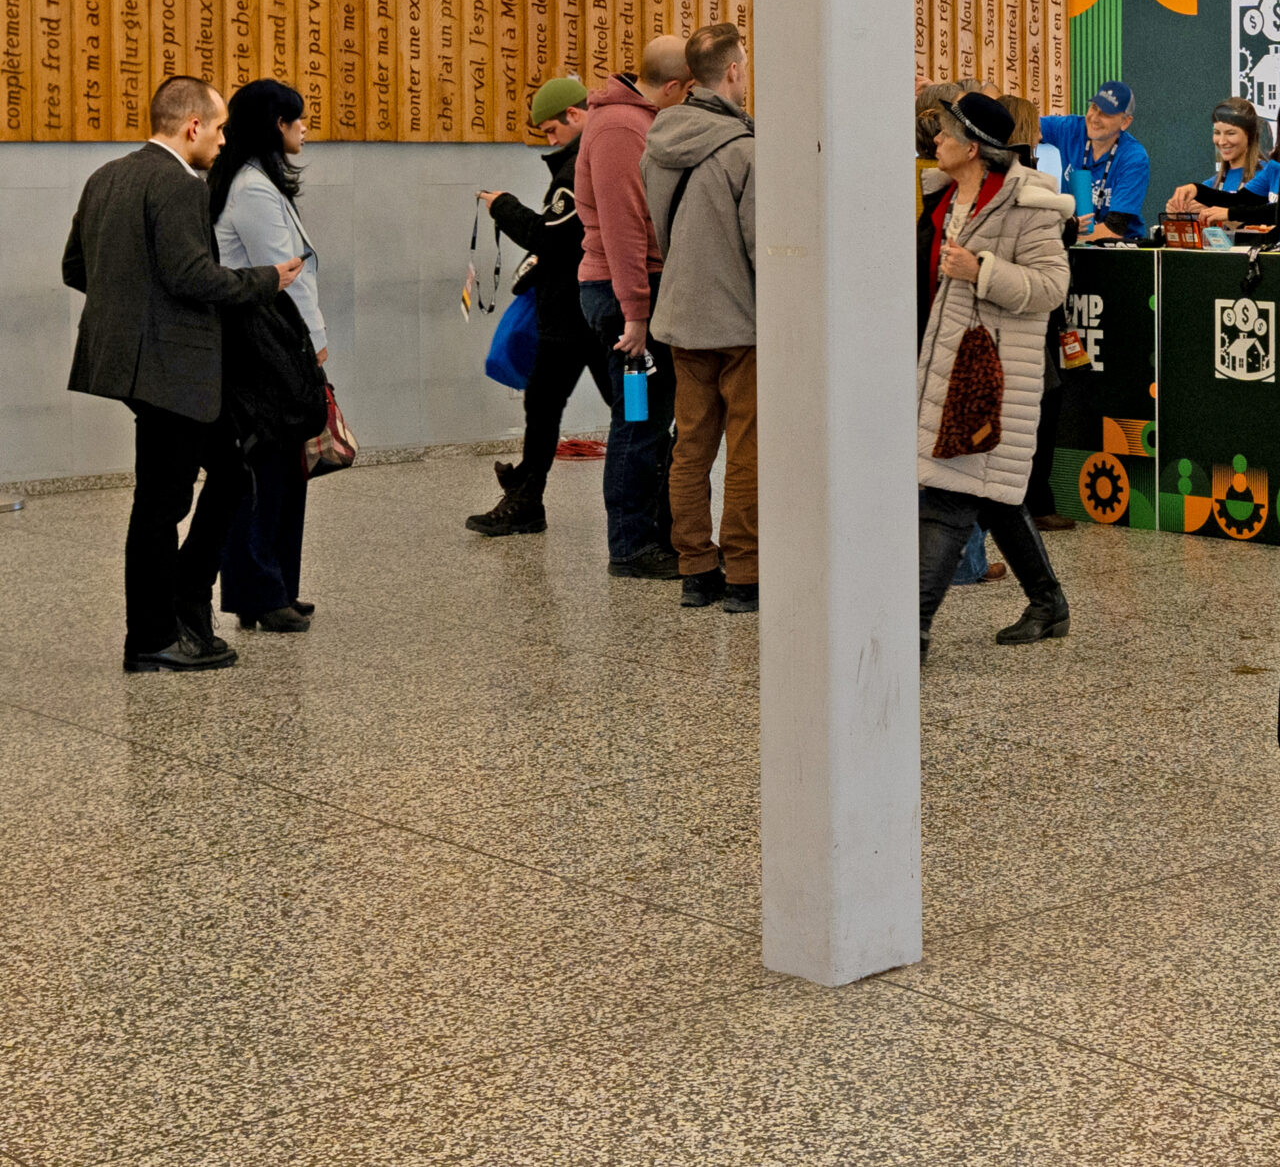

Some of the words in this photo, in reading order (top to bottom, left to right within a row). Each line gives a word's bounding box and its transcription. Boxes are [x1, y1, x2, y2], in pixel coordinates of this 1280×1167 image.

[343, 2, 355, 30] me
[736, 3, 747, 27] me
[1054, 12, 1061, 30] en
[39, 16, 61, 73] froid
[81, 34, 100, 71] m'a
[339, 38, 360, 55] je
[409, 24, 420, 60] une
[441, 24, 452, 48] un
[940, 28, 948, 56] ses
[1052, 34, 1061, 68] sont
[162, 48, 175, 76] me
[339, 61, 355, 83] où
[437, 54, 455, 83] j'ai
[937, 64, 948, 80] et
[1029, 42, 1040, 92] tombe.
[43, 82, 62, 130] très
[83, 78, 101, 129] arts
[407, 64, 421, 132] monter
[469, 56, 487, 130] Dorval.
[1051, 73, 1063, 108] lilas
[339, 90, 356, 128] fois
